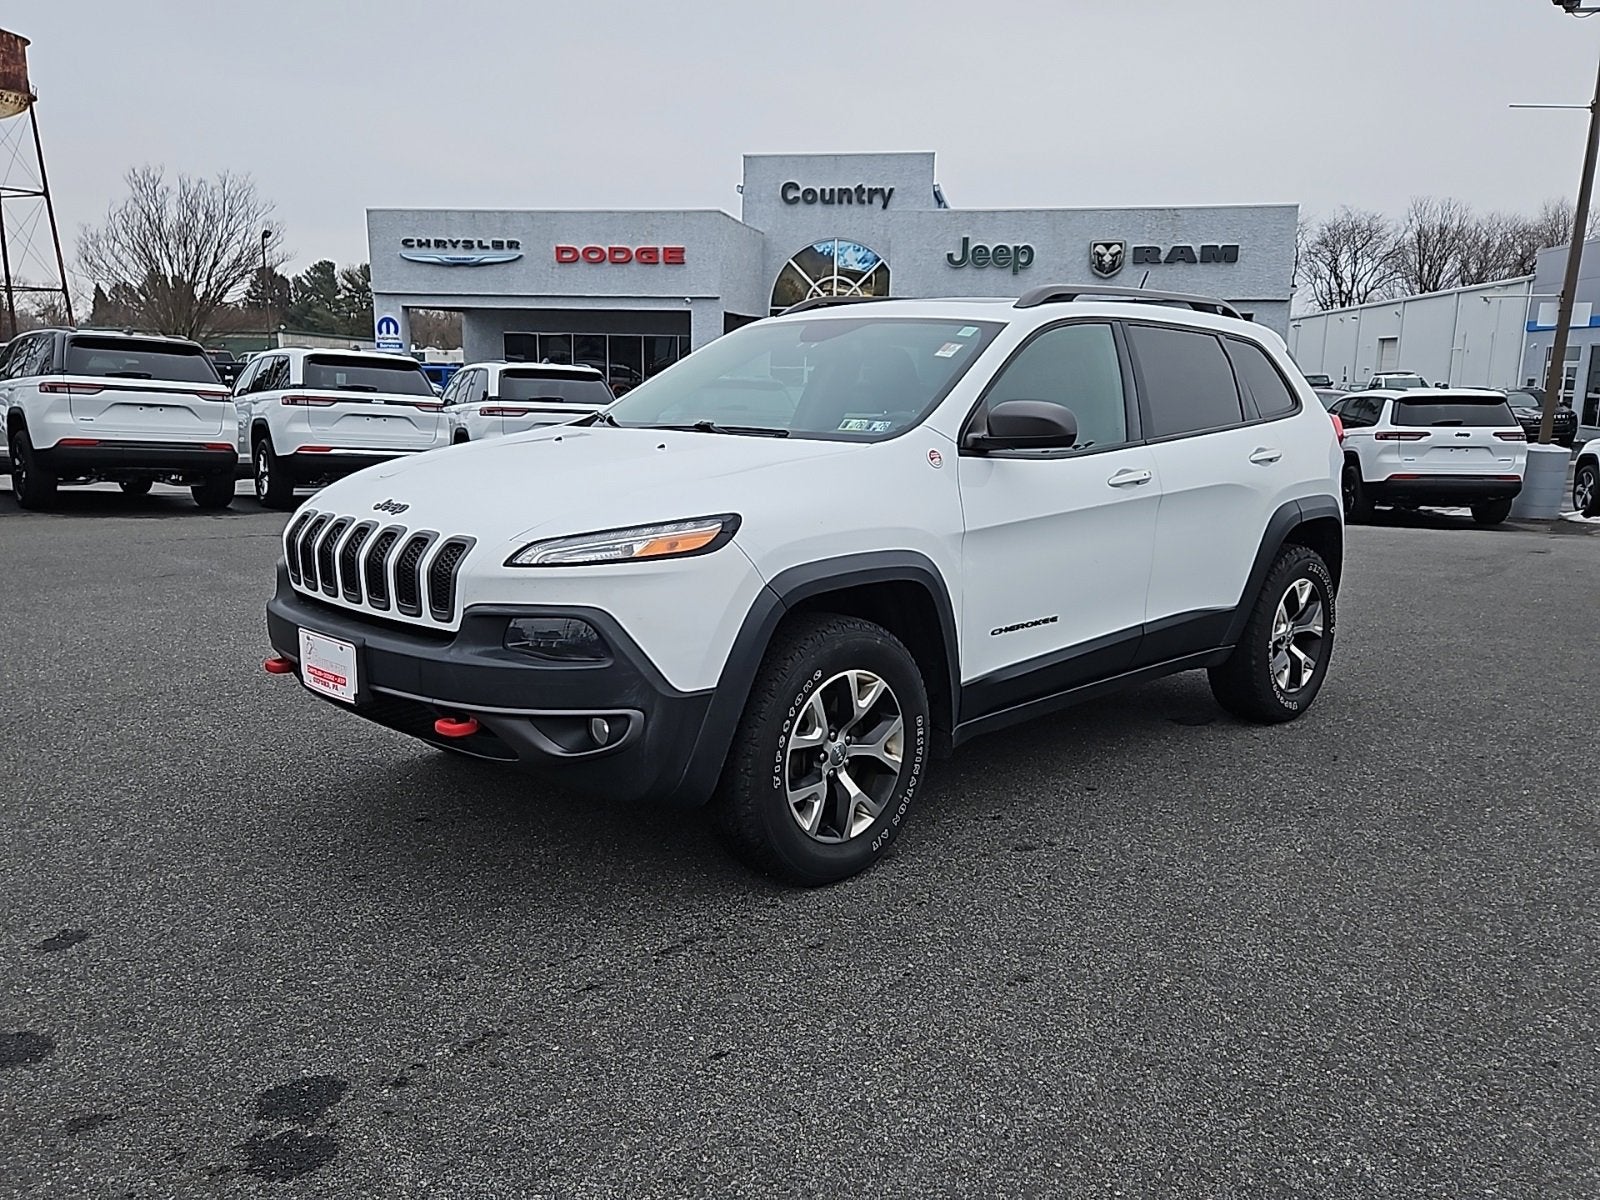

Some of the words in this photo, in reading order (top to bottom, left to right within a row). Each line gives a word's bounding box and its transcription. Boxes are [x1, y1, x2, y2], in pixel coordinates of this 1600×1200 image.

[781, 181, 895, 210] Country
[401, 238, 521, 250] CHRYSLER
[1132, 244, 1240, 264] RAM
[555, 245, 686, 265] DODGE
[946, 236, 1035, 275] Jeep
[373, 498, 410, 516] Jeep
[990, 615, 1059, 636] CHEROKEE
[892, 715, 924, 826] DESTINATION
[871, 828, 890, 852] A/T
